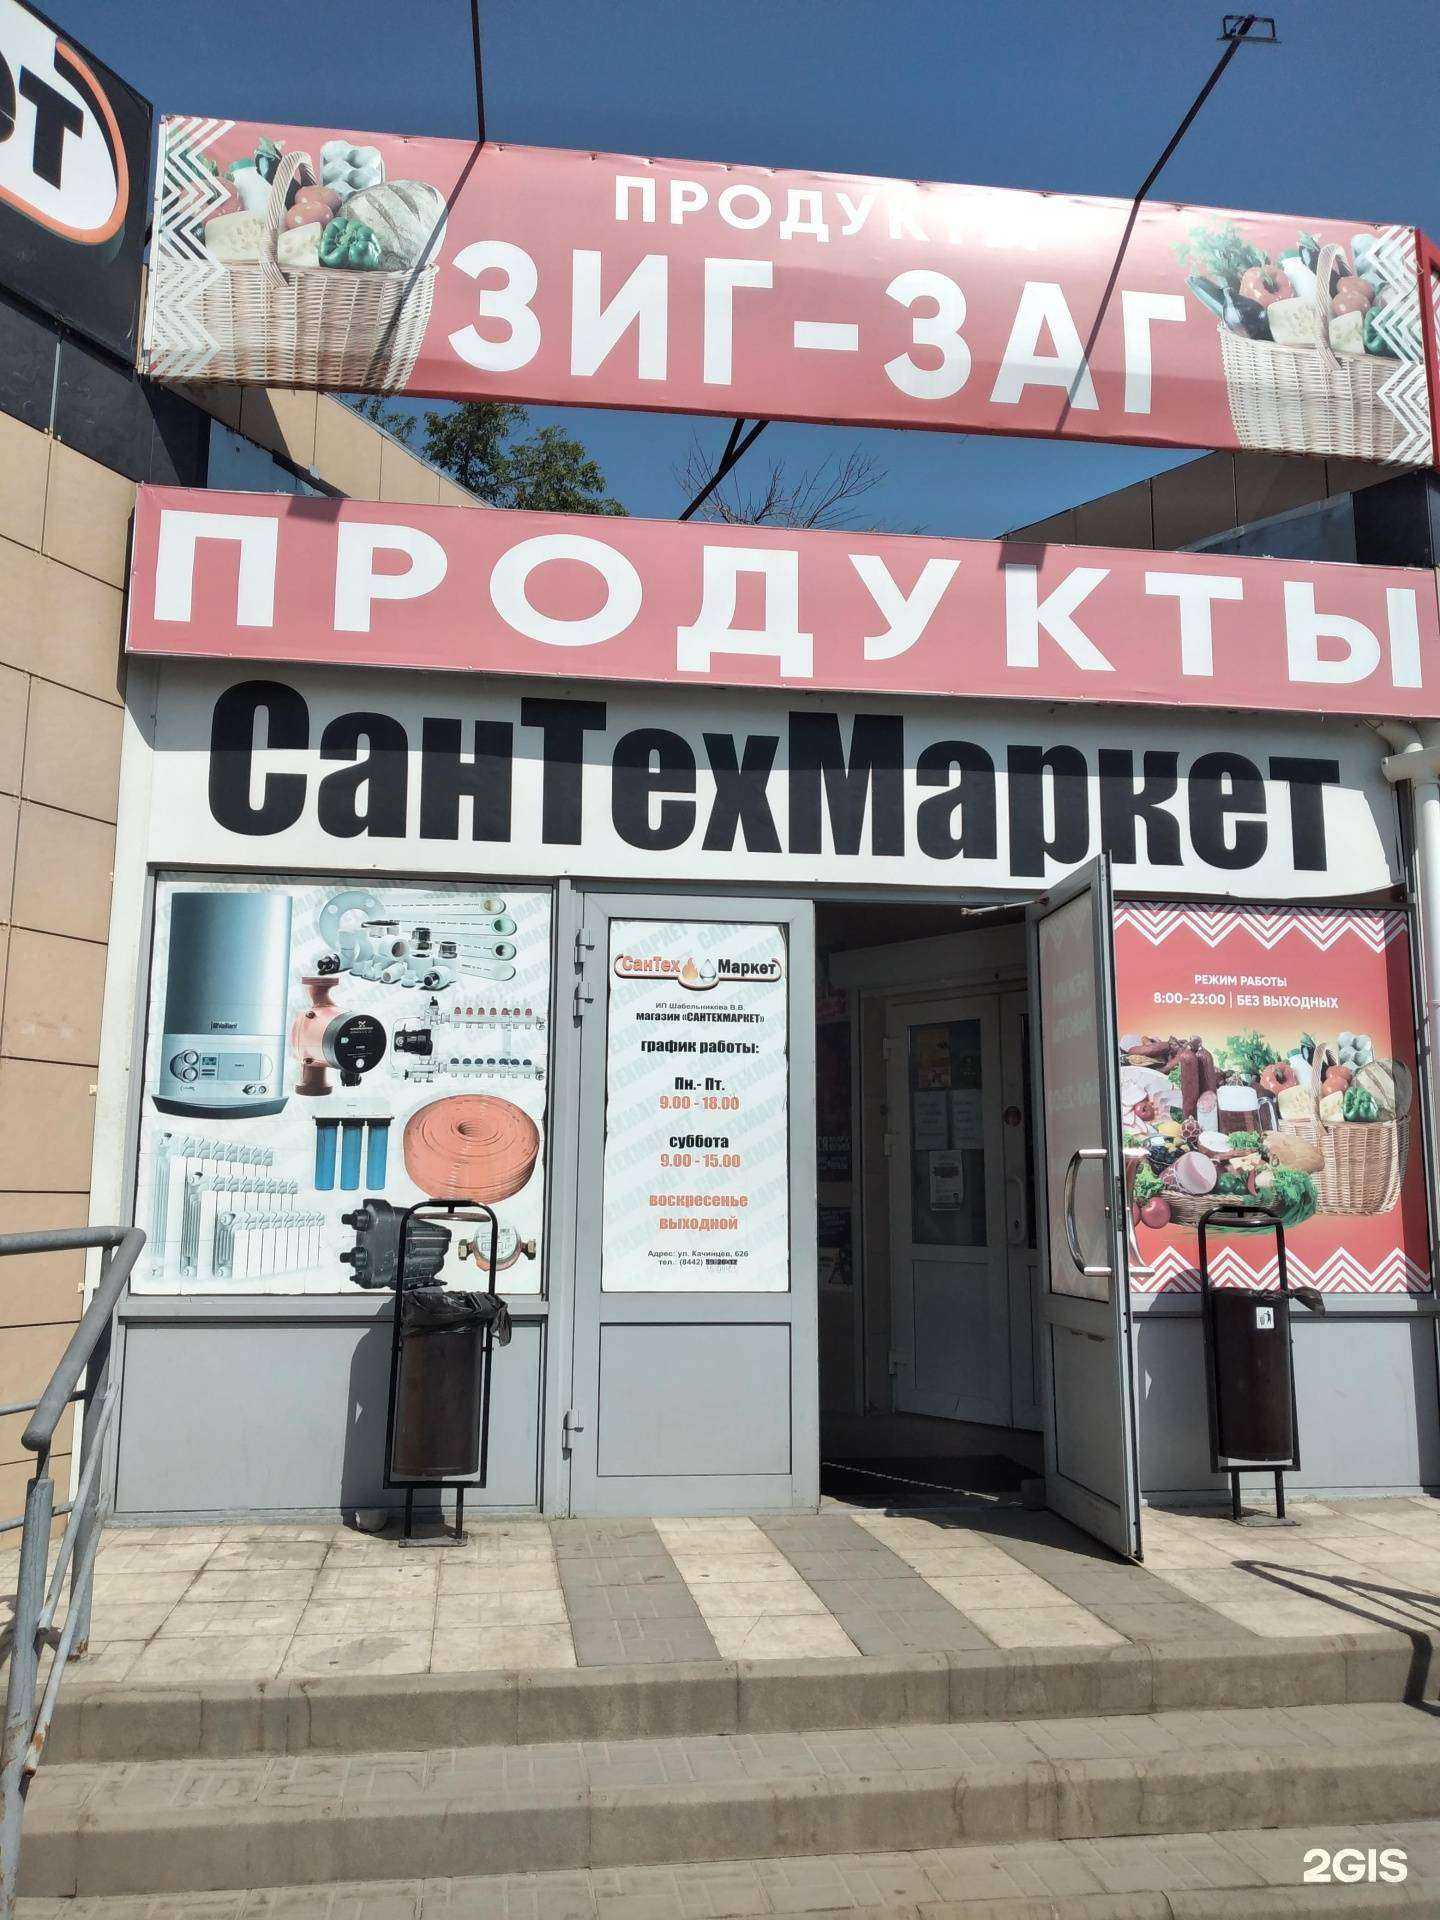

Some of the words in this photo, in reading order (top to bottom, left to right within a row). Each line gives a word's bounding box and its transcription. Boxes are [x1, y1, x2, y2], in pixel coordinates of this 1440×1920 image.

[615, 173, 1041, 250] ПРОДУК
[448, 240, 1187, 415] ЗИГ-ЗАГ
[154, 509, 1423, 688] ПРОДУКТЫ
[208, 680, 1341, 878] СанТехМаркет
[622, 956, 681, 973] СанТех
[718, 958, 777, 976] Маркет
[1194, 974, 1237, 986] РЕЖИМ
[1240, 975, 1287, 987] РАБОТЫ
[655, 1002, 667, 1010] ИП
[1153, 992, 1225, 1006] 8:00-23:00
[1237, 994, 1260, 1007] БЕЗ
[1263, 995, 1339, 1010] ВЫХОДНЫХ
[636, 1012, 680, 1021] магазин
[641, 1040, 697, 1054] график
[699, 1040, 760, 1054] работы:
[705, 1078, 725, 1091] Пт.
[659, 1096, 690, 1109] 9.00
[702, 1096, 740, 1110] 18.00
[669, 1135, 729, 1149] суббота
[660, 1153, 691, 1167] 9.00
[702, 1154, 741, 1168] 15.00
[649, 1195, 748, 1209] воскресенье
[659, 1216, 738, 1232] выходной
